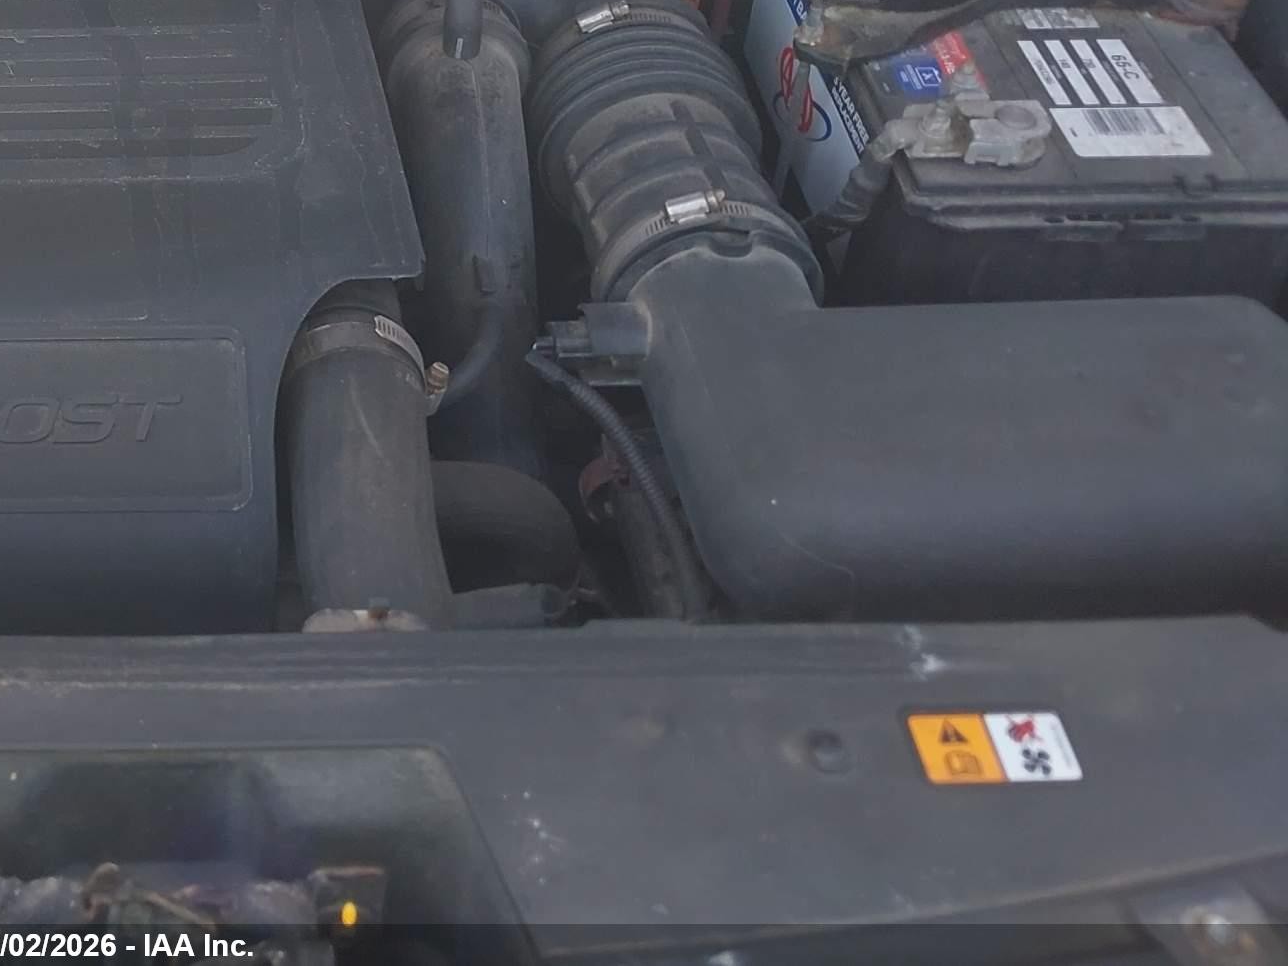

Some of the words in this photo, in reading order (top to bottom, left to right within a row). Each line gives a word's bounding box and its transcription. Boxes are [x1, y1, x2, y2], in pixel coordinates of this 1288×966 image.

[832, 86, 865, 154] REPLACEMENT
[839, 81, 855, 115] YEAR
[853, 111, 869, 146] FREE
